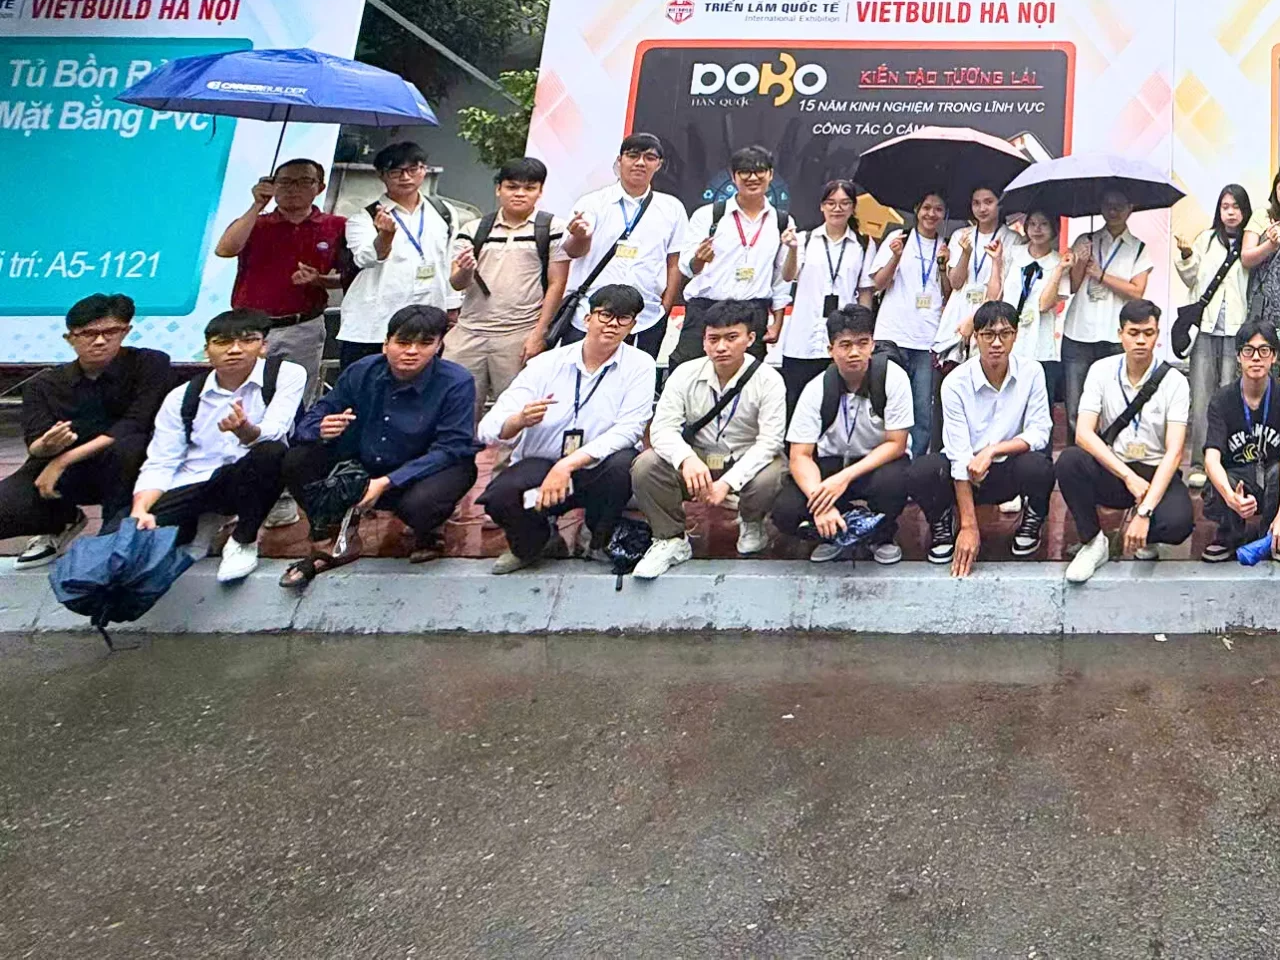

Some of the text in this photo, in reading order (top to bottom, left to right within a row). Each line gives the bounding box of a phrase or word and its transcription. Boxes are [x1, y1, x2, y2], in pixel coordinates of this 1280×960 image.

[704, 0, 743, 13] TRIỂN
[781, 0, 818, 14] QUỐC
[823, 0, 841, 13] TẾ
[856, 1, 971, 23] VIETBUILD
[10, 58, 48, 88] Tủ
[52, 53, 118, 88] Bồn
[944, 67, 1004, 85] TƯƠNG
[0, 100, 53, 137] Mặt
[58, 94, 143, 138] Bằng
[799, 99, 1045, 115] 15 NĂM KINH NGHIỆM TRONG LĨNH VỰC
[812, 122, 851, 135] CÔNG
[9, 251, 43, 278] trí:
[44, 250, 161, 279] A5-1121
